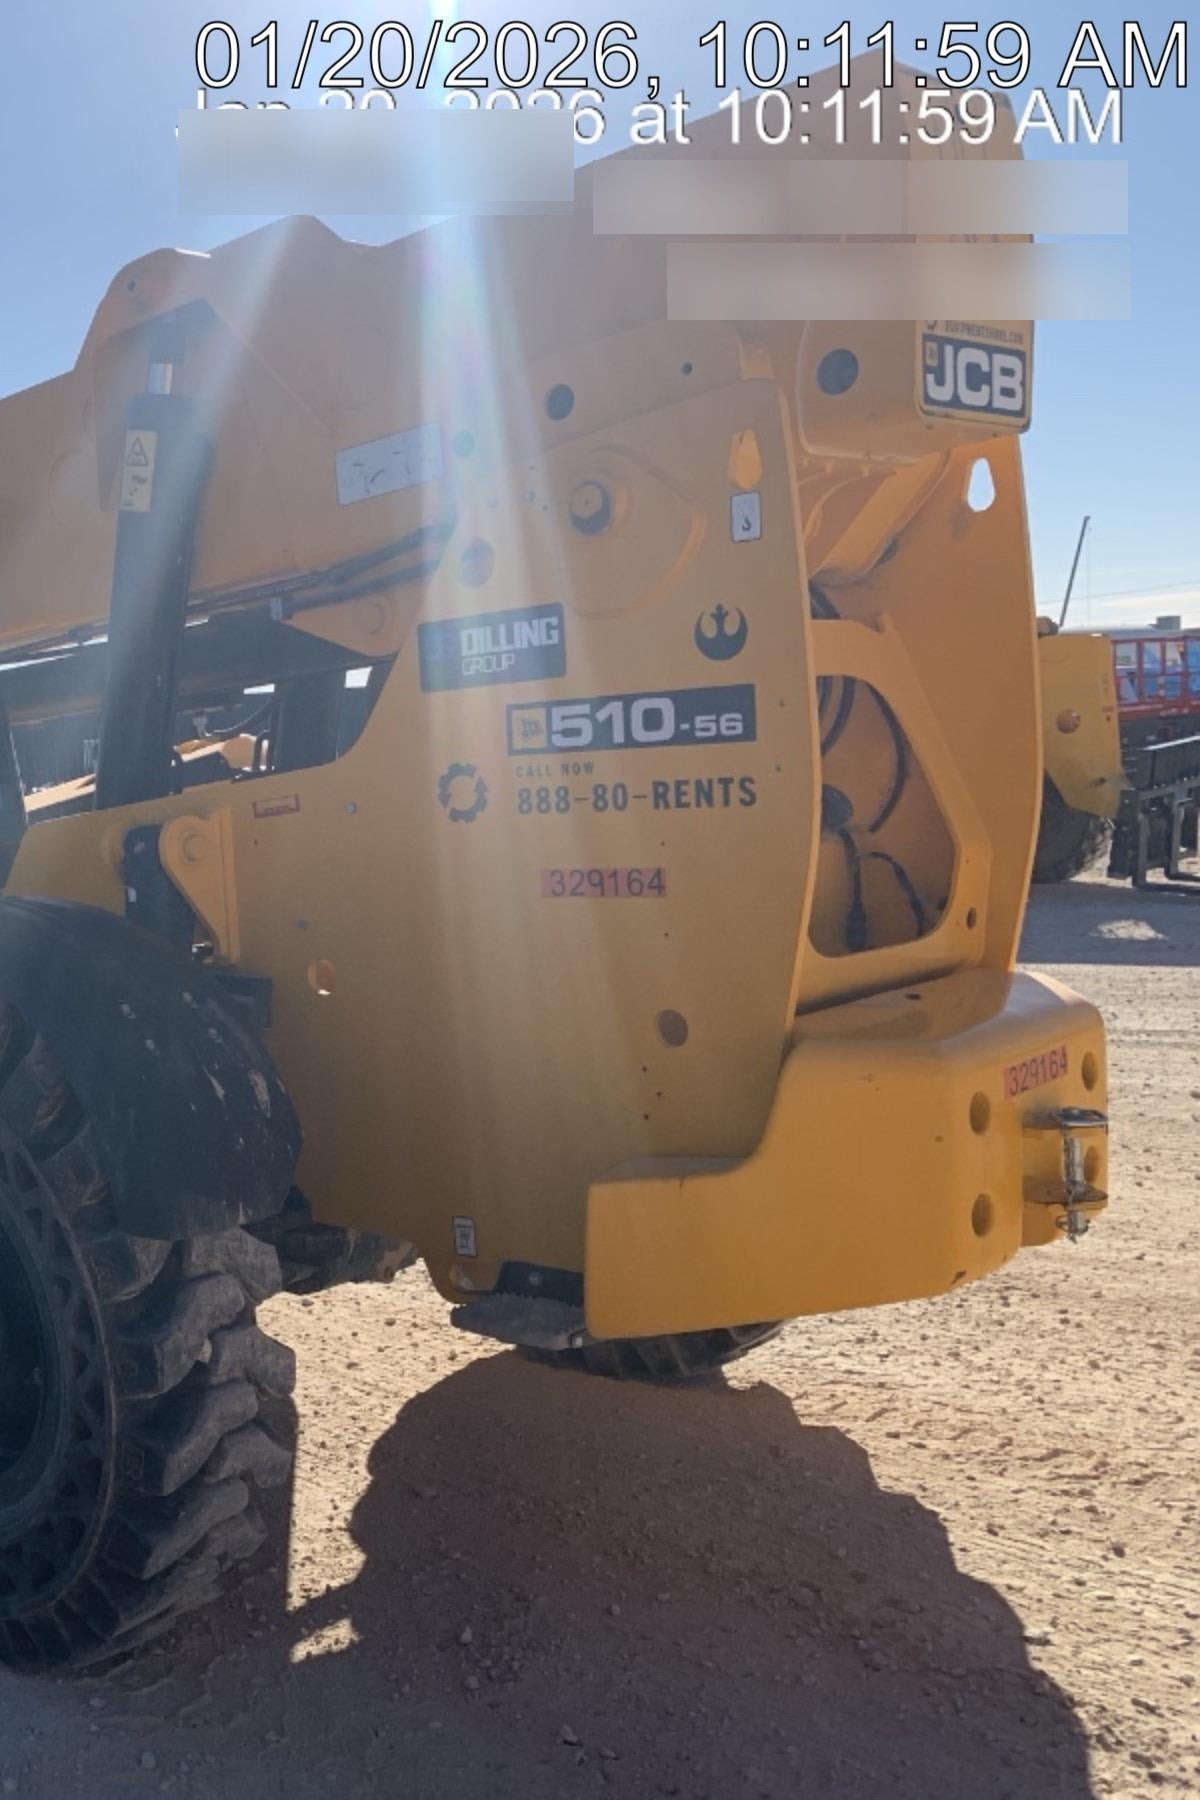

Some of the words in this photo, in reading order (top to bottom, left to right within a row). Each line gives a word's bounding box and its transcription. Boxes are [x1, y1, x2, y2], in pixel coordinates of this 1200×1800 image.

[926, 344, 1023, 411] JCB
[460, 616, 560, 656] DILLING
[462, 653, 516, 676] GROUP
[550, 697, 744, 748] 510-56
[515, 765, 553, 778] CALL
[560, 761, 595, 777] NOW
[517, 776, 758, 815] 888-80-RENTS
[550, 868, 666, 897] 329164
[1008, 1046, 1067, 1096] 329164
